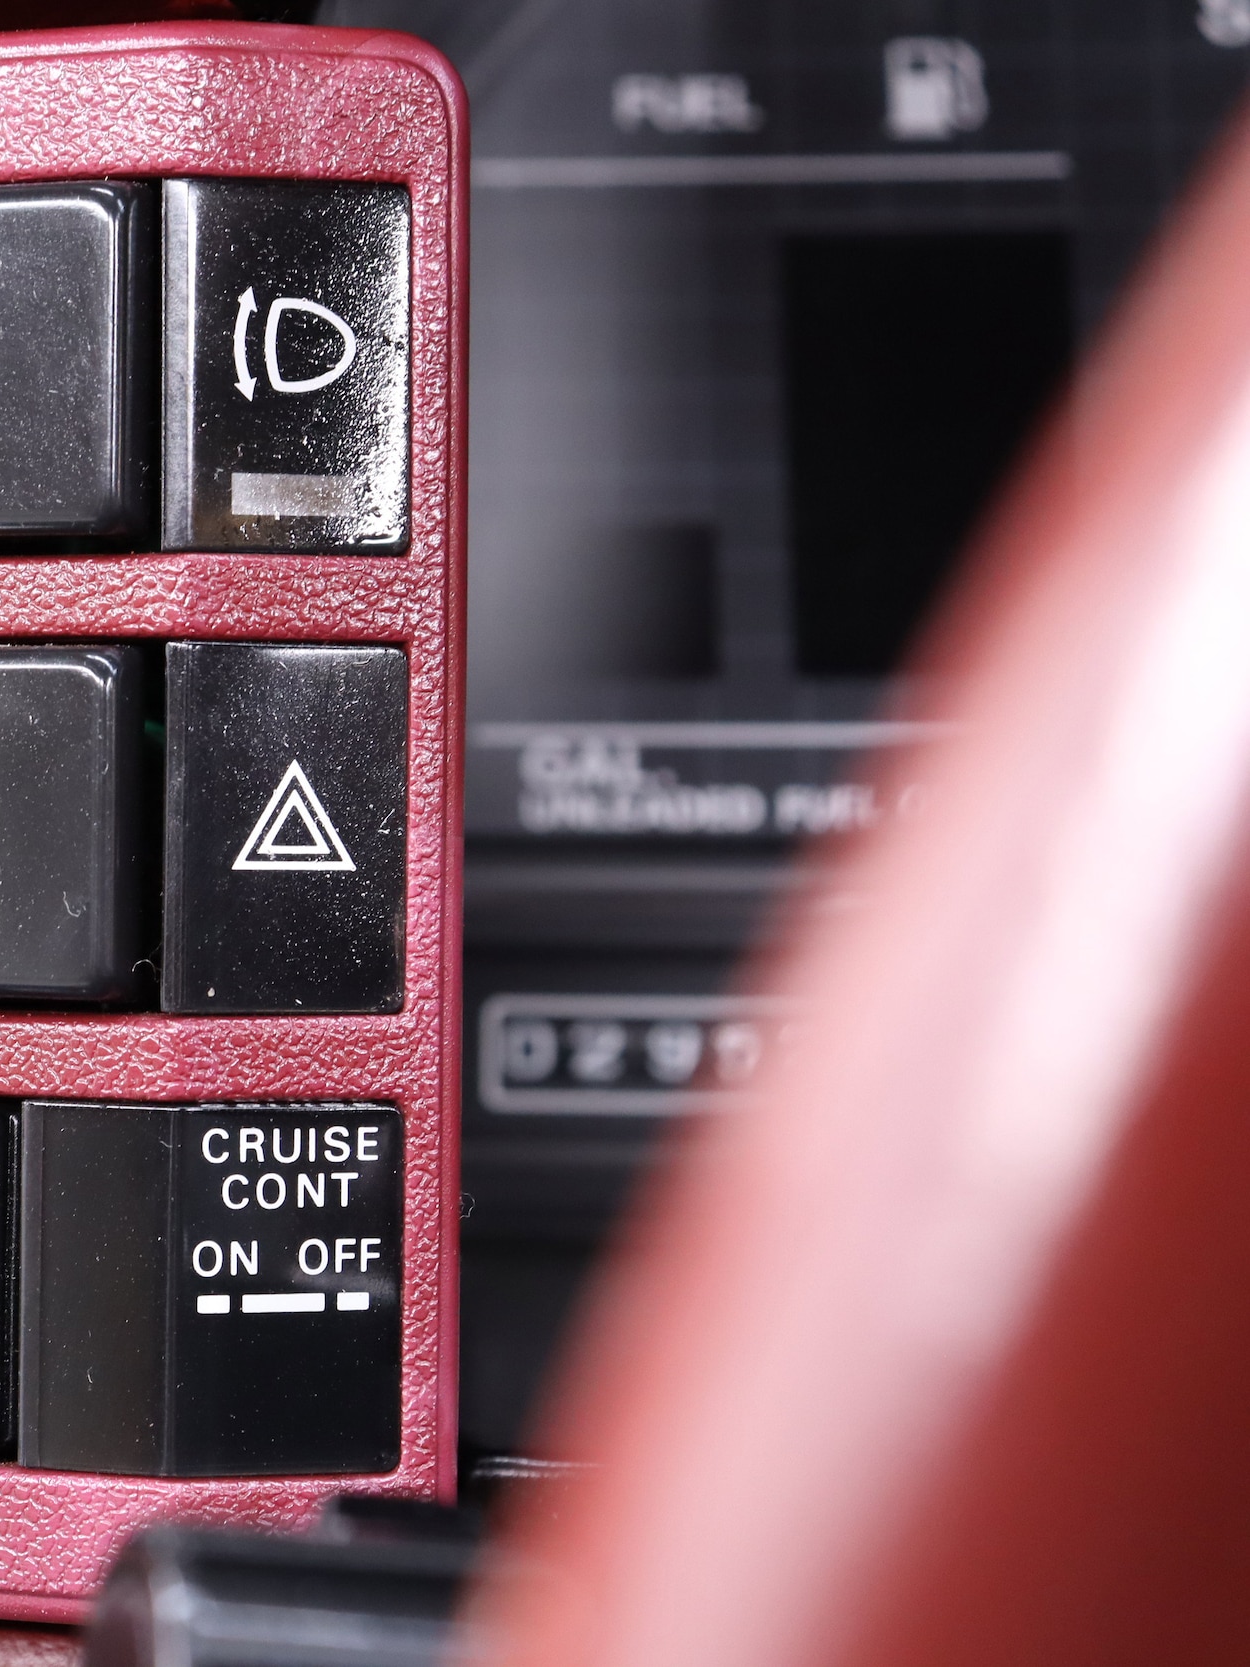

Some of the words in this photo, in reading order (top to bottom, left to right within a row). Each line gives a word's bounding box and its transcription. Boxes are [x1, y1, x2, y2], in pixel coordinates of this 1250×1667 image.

[612, 74, 762, 132] FUEL
[201, 1126, 379, 1164] CRUISE
[221, 1172, 359, 1210] CONT
[192, 1239, 259, 1277] ON
[298, 1238, 381, 1275] OFF
